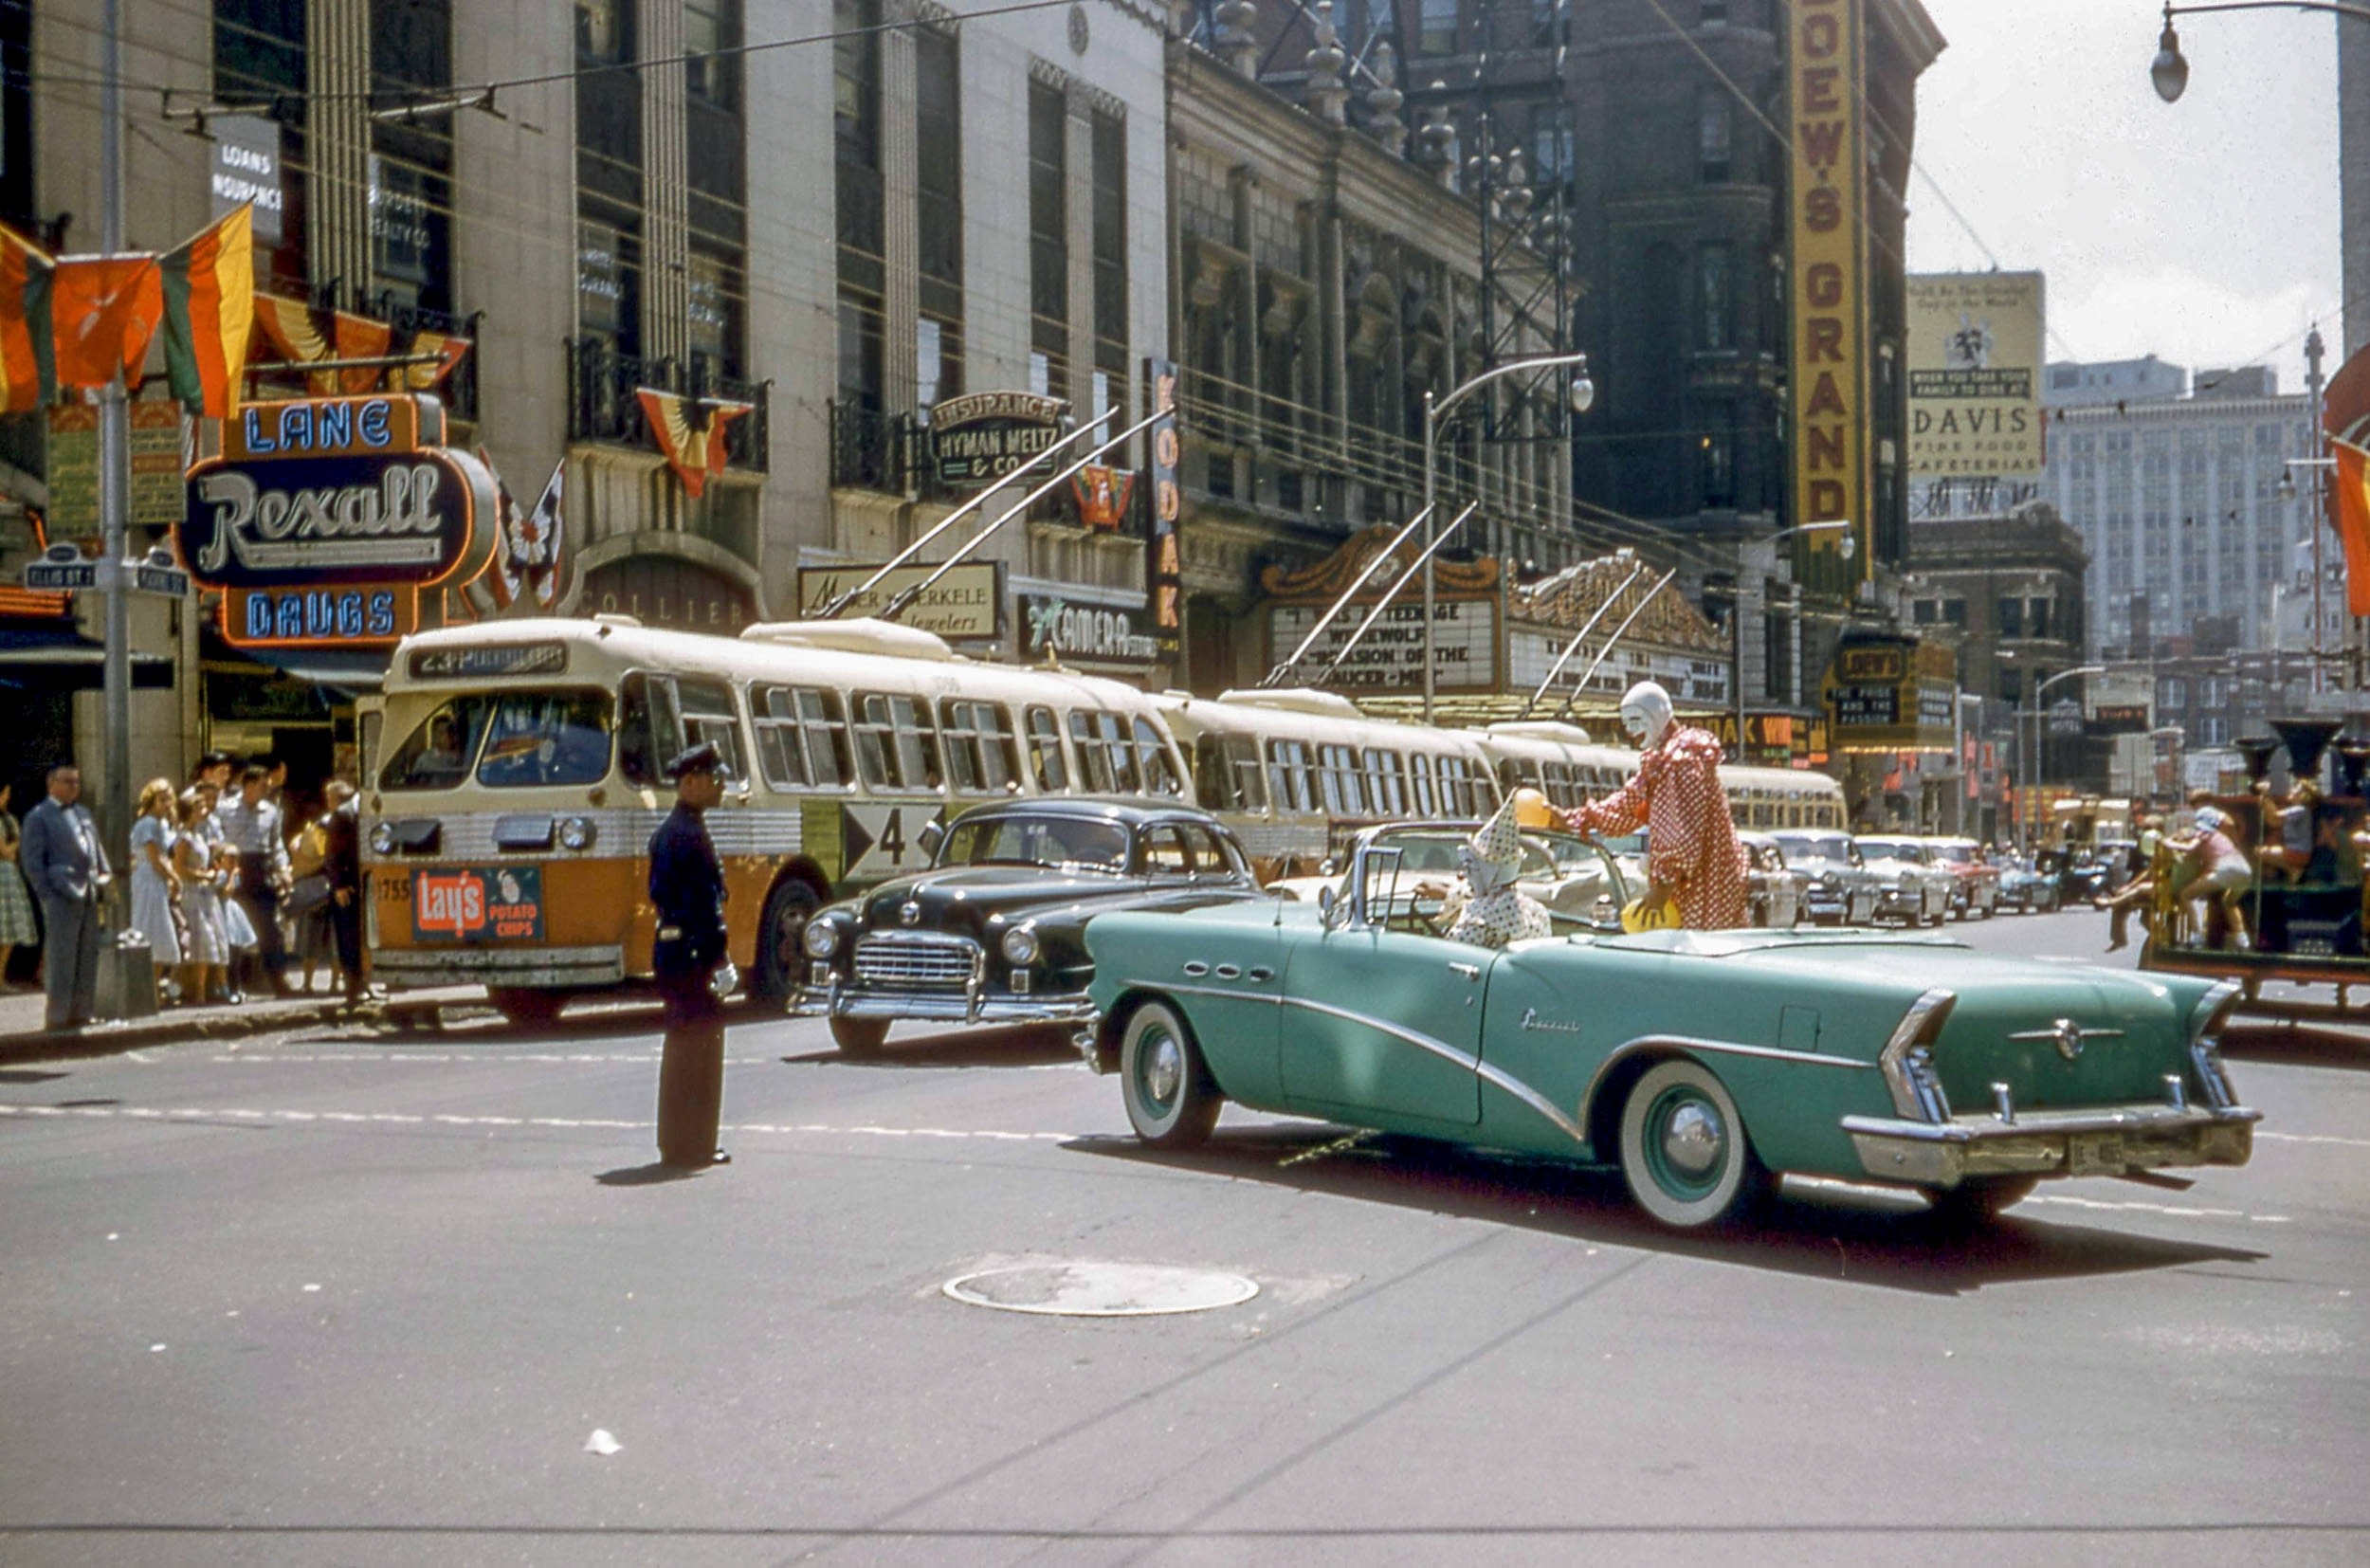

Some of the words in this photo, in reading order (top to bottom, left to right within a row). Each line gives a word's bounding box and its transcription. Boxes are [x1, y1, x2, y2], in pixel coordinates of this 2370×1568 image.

[1800, 0, 1845, 233] OEW'S
[222, 144, 271, 174] LOANS
[935, 392, 1055, 424] INSURANCE
[1806, 262, 1848, 522] GRAND
[245, 399, 392, 454] LANE
[1914, 407, 2027, 434] DAVIS
[939, 430, 1001, 458] HYMAN
[1006, 427, 1058, 454] MELTZ
[1914, 440, 1961, 452] FINE
[1975, 439, 2028, 452] FOOD
[971, 457, 990, 477] &
[197, 464, 442, 572] Rexall
[1157, 374, 1179, 629] KODAK
[581, 591, 743, 626] COLLIER
[810, 574, 880, 611] MER
[916, 586, 989, 608] ERKELE
[246, 591, 395, 639] DRUGS
[909, 612, 978, 632] Jewelers
[1052, 606, 1132, 658] CAMERA
[1433, 646, 1469, 663] THE
[1841, 701, 1866, 712] AND
[1871, 700, 1891, 712] THE
[878, 807, 906, 866] 4
[419, 870, 481, 937] Lay's
[489, 903, 538, 921] POTATO
[495, 921, 534, 937] CHIPS
